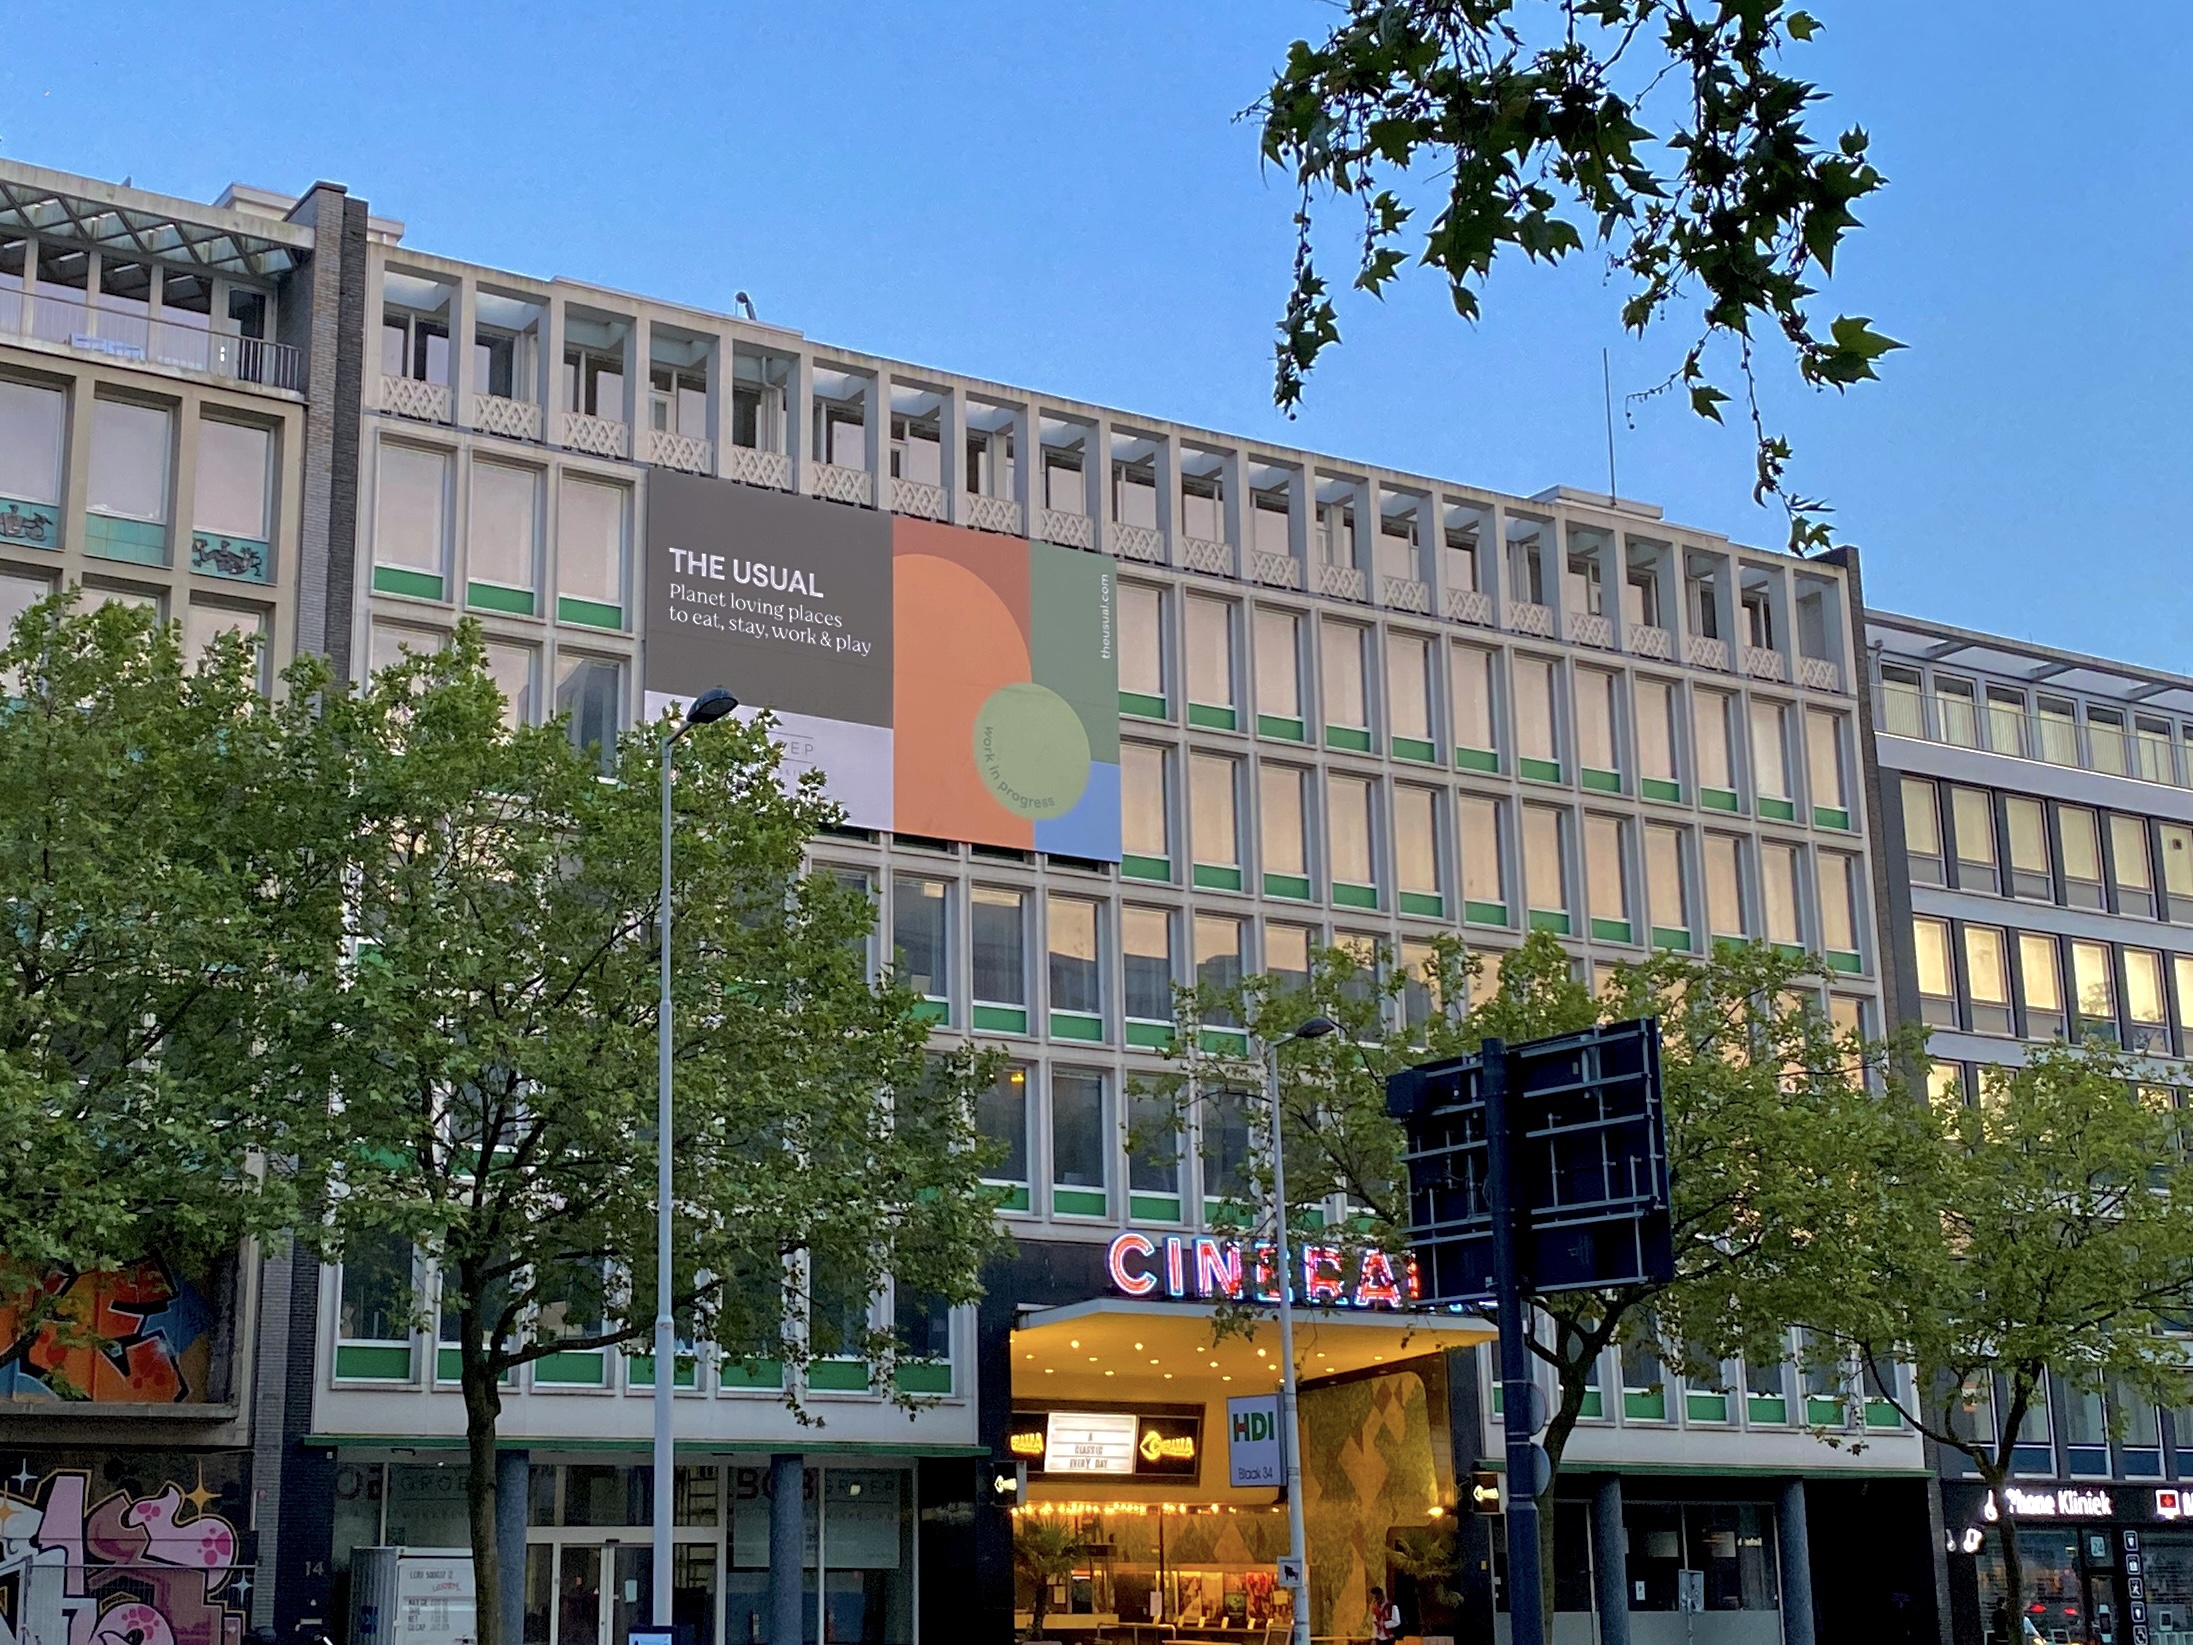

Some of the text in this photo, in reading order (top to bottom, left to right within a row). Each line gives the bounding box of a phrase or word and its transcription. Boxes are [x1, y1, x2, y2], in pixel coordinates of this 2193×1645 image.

[669, 547, 824, 598] THE USUAL
[670, 583, 843, 628] Planet loving places
[669, 606, 871, 657] to eat, stay, work & play
[787, 740, 814, 756] EP
[983, 726, 1055, 809] work in progress
[1107, 1232, 1419, 1307] CINERA
[1233, 1411, 1275, 1442] HDI
[1087, 1432, 1094, 1442] A
[1075, 1445, 1103, 1456] CLASSIC
[1069, 1458, 1108, 1469] EVERY DAY
[1263, 1466, 1273, 1479] 34
[825, 1479, 894, 1495] GREP
[2058, 1489, 2112, 1515] Kliniek
[2092, 1542, 2104, 1554] 24
[305, 1561, 325, 1577] 14
